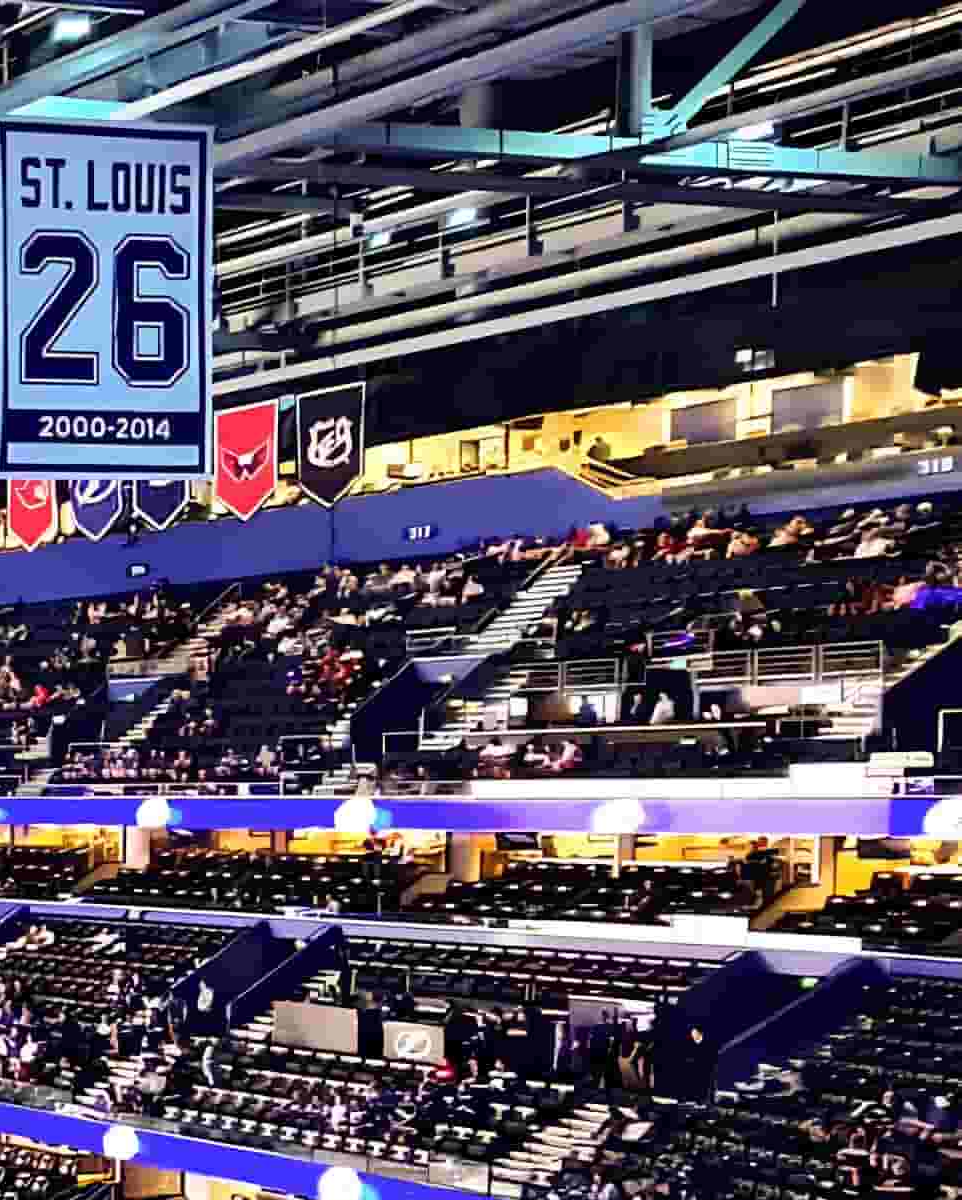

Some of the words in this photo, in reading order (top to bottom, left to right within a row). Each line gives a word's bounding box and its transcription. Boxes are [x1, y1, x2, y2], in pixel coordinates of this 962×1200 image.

[20, 157, 74, 210] ST.
[86, 159, 191, 215] LOUIS
[19, 229, 191, 389] 26
[38, 414, 171, 441] 2000-2014
